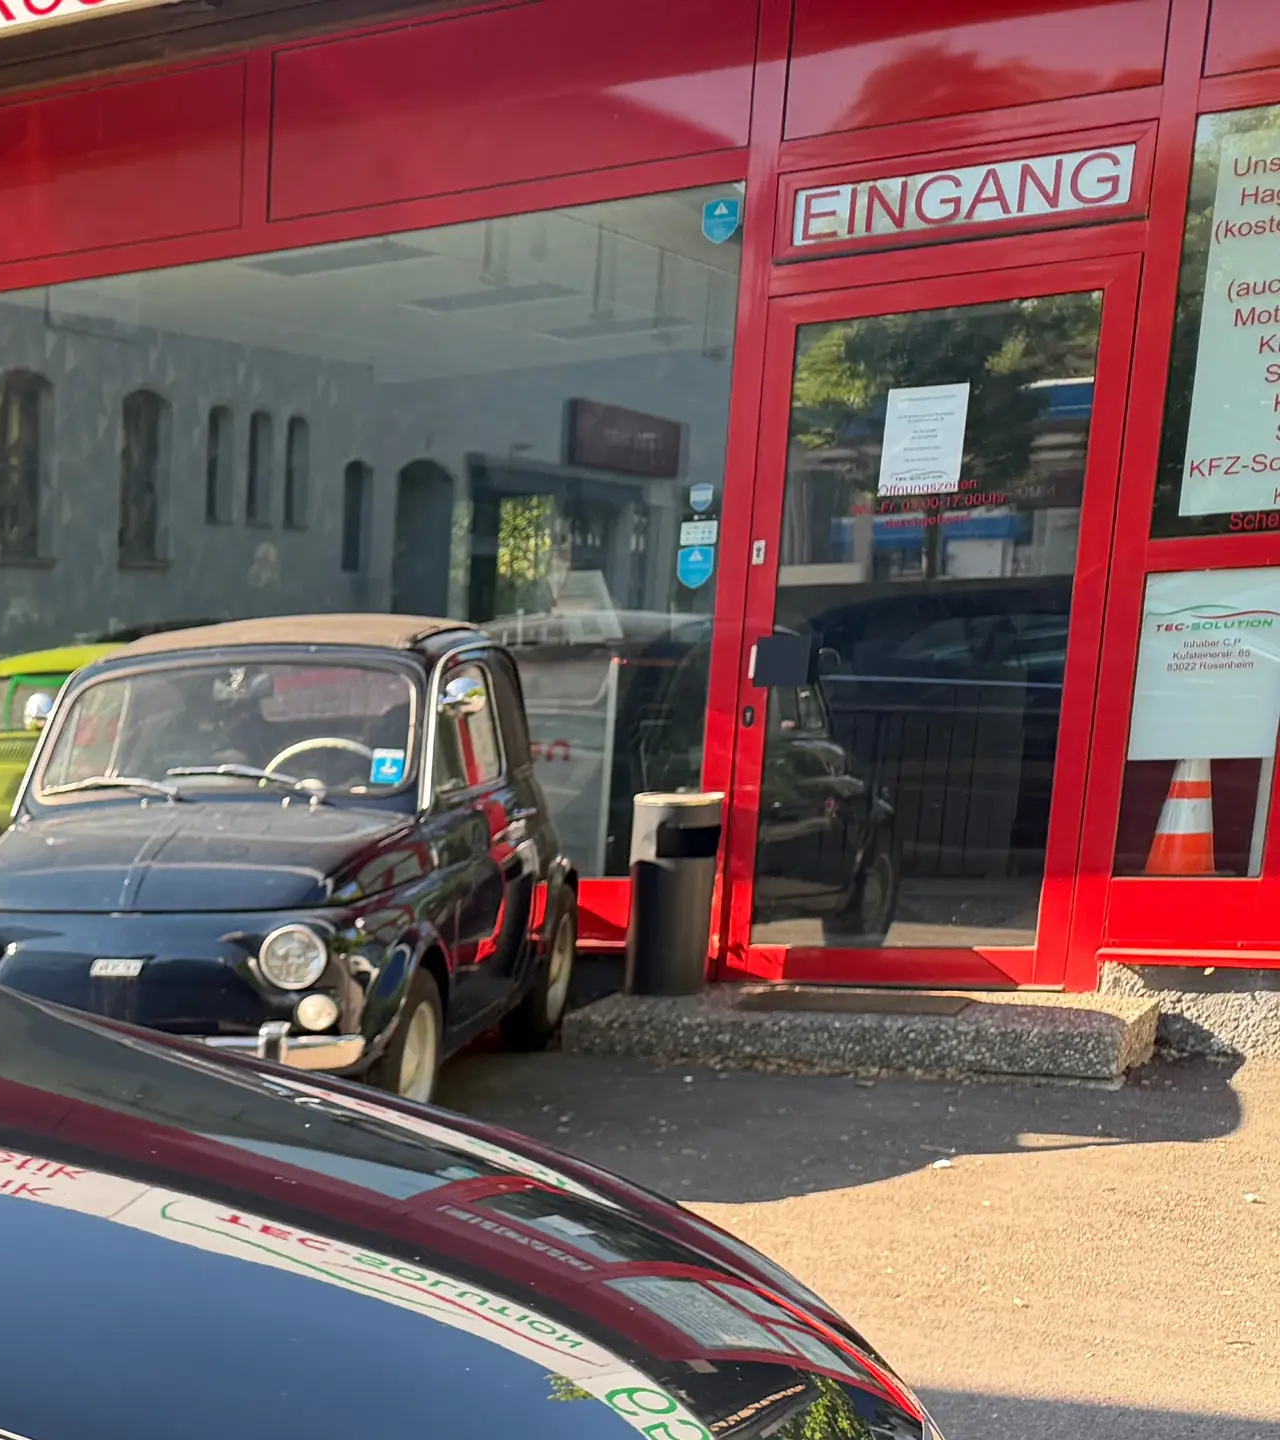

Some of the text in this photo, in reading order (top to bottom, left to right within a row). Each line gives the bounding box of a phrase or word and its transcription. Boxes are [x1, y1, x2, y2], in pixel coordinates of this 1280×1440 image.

[801, 151, 1121, 242] EINGANG
[1241, 186, 1280, 206] Ha
[1214, 215, 1280, 244] (kost
[1155, 618, 1274, 632] TEC-SOLUTION
